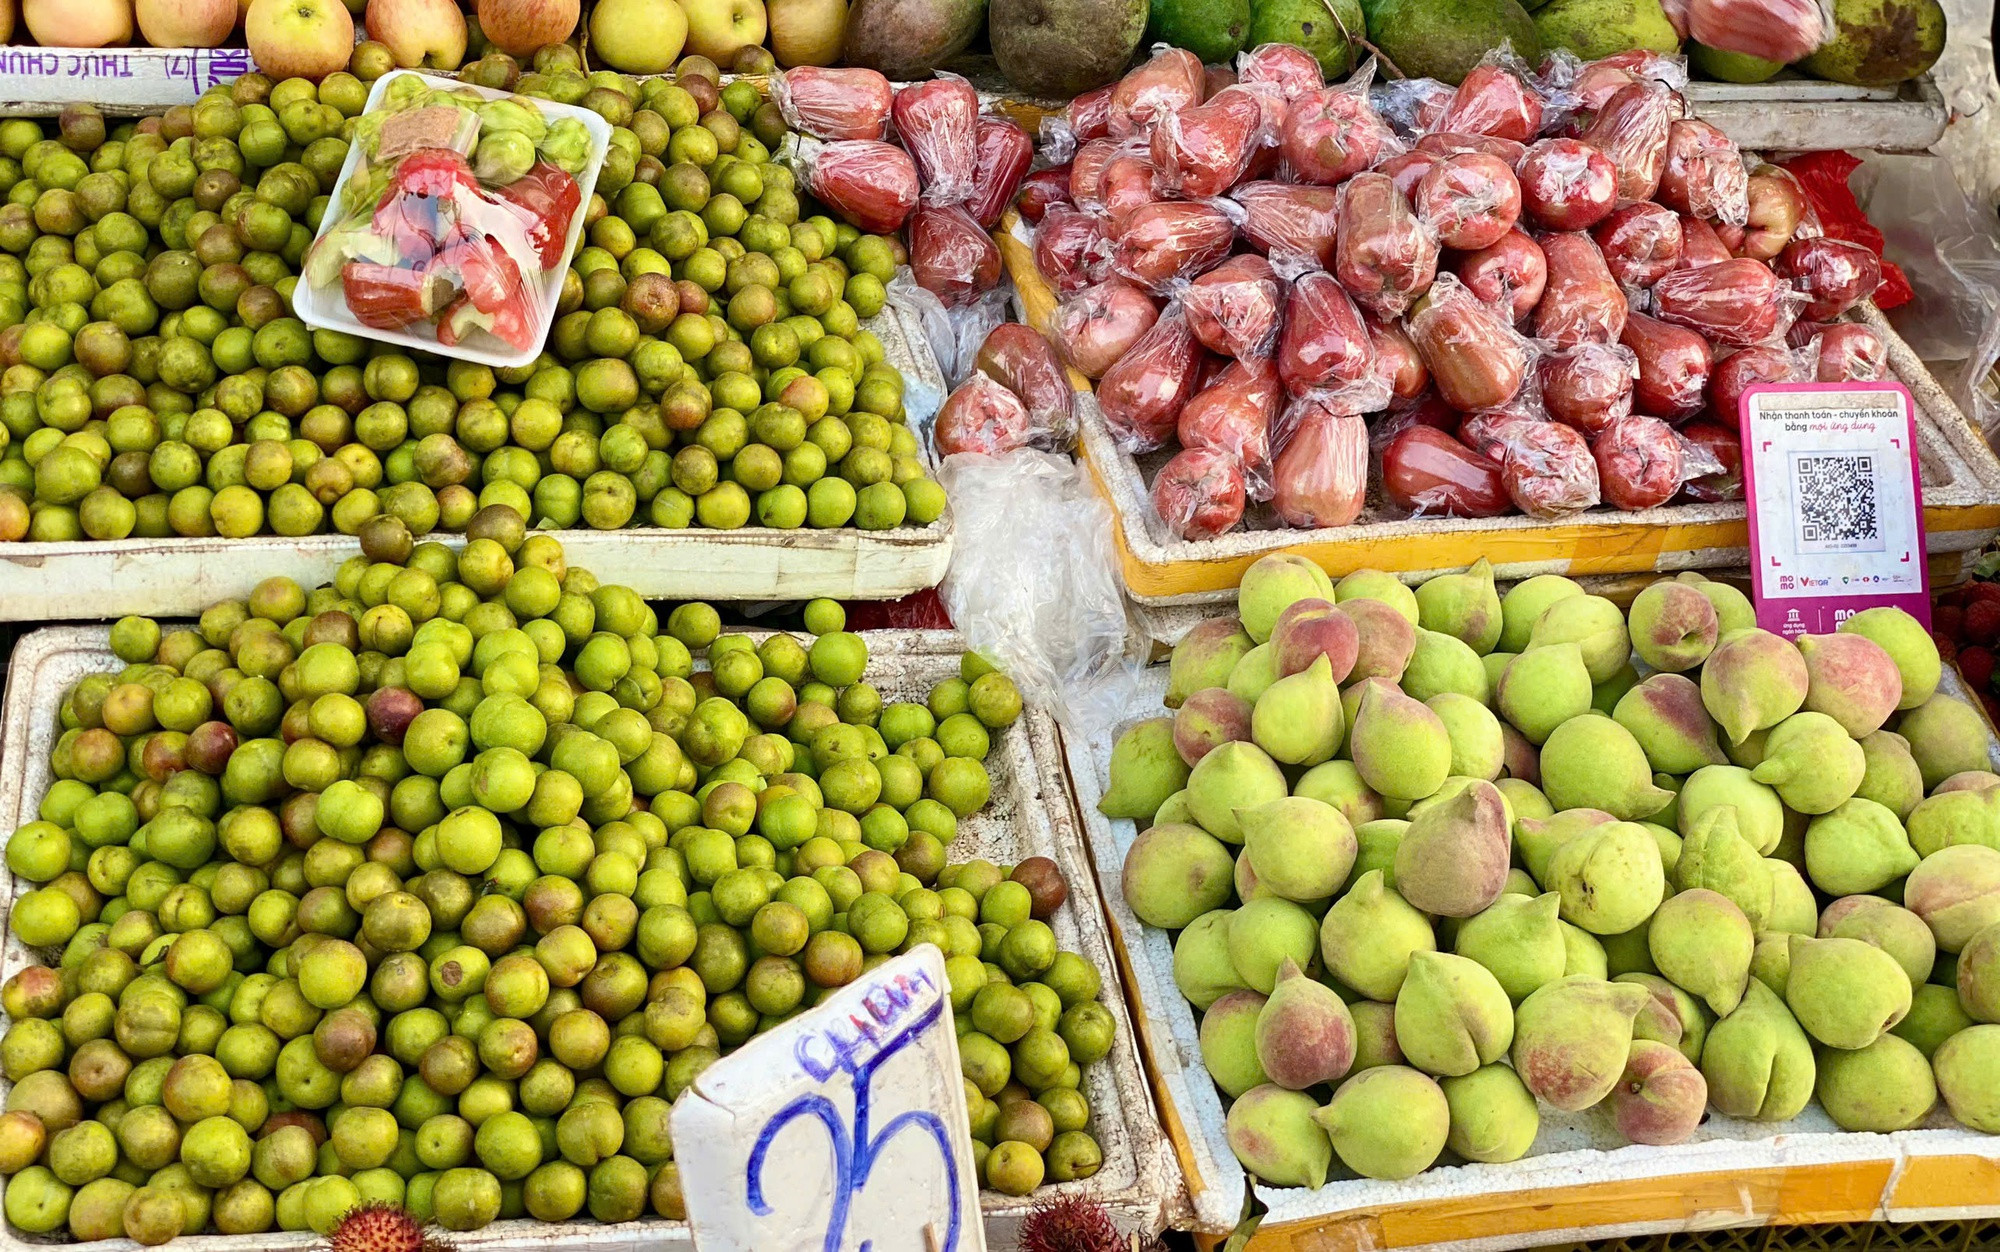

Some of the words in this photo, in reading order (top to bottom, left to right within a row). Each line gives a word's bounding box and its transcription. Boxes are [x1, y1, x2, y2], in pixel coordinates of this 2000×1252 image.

[1760, 412, 1782, 421] Nhận
[1785, 411, 1810, 420] thanh
[1812, 411, 1832, 419] toán
